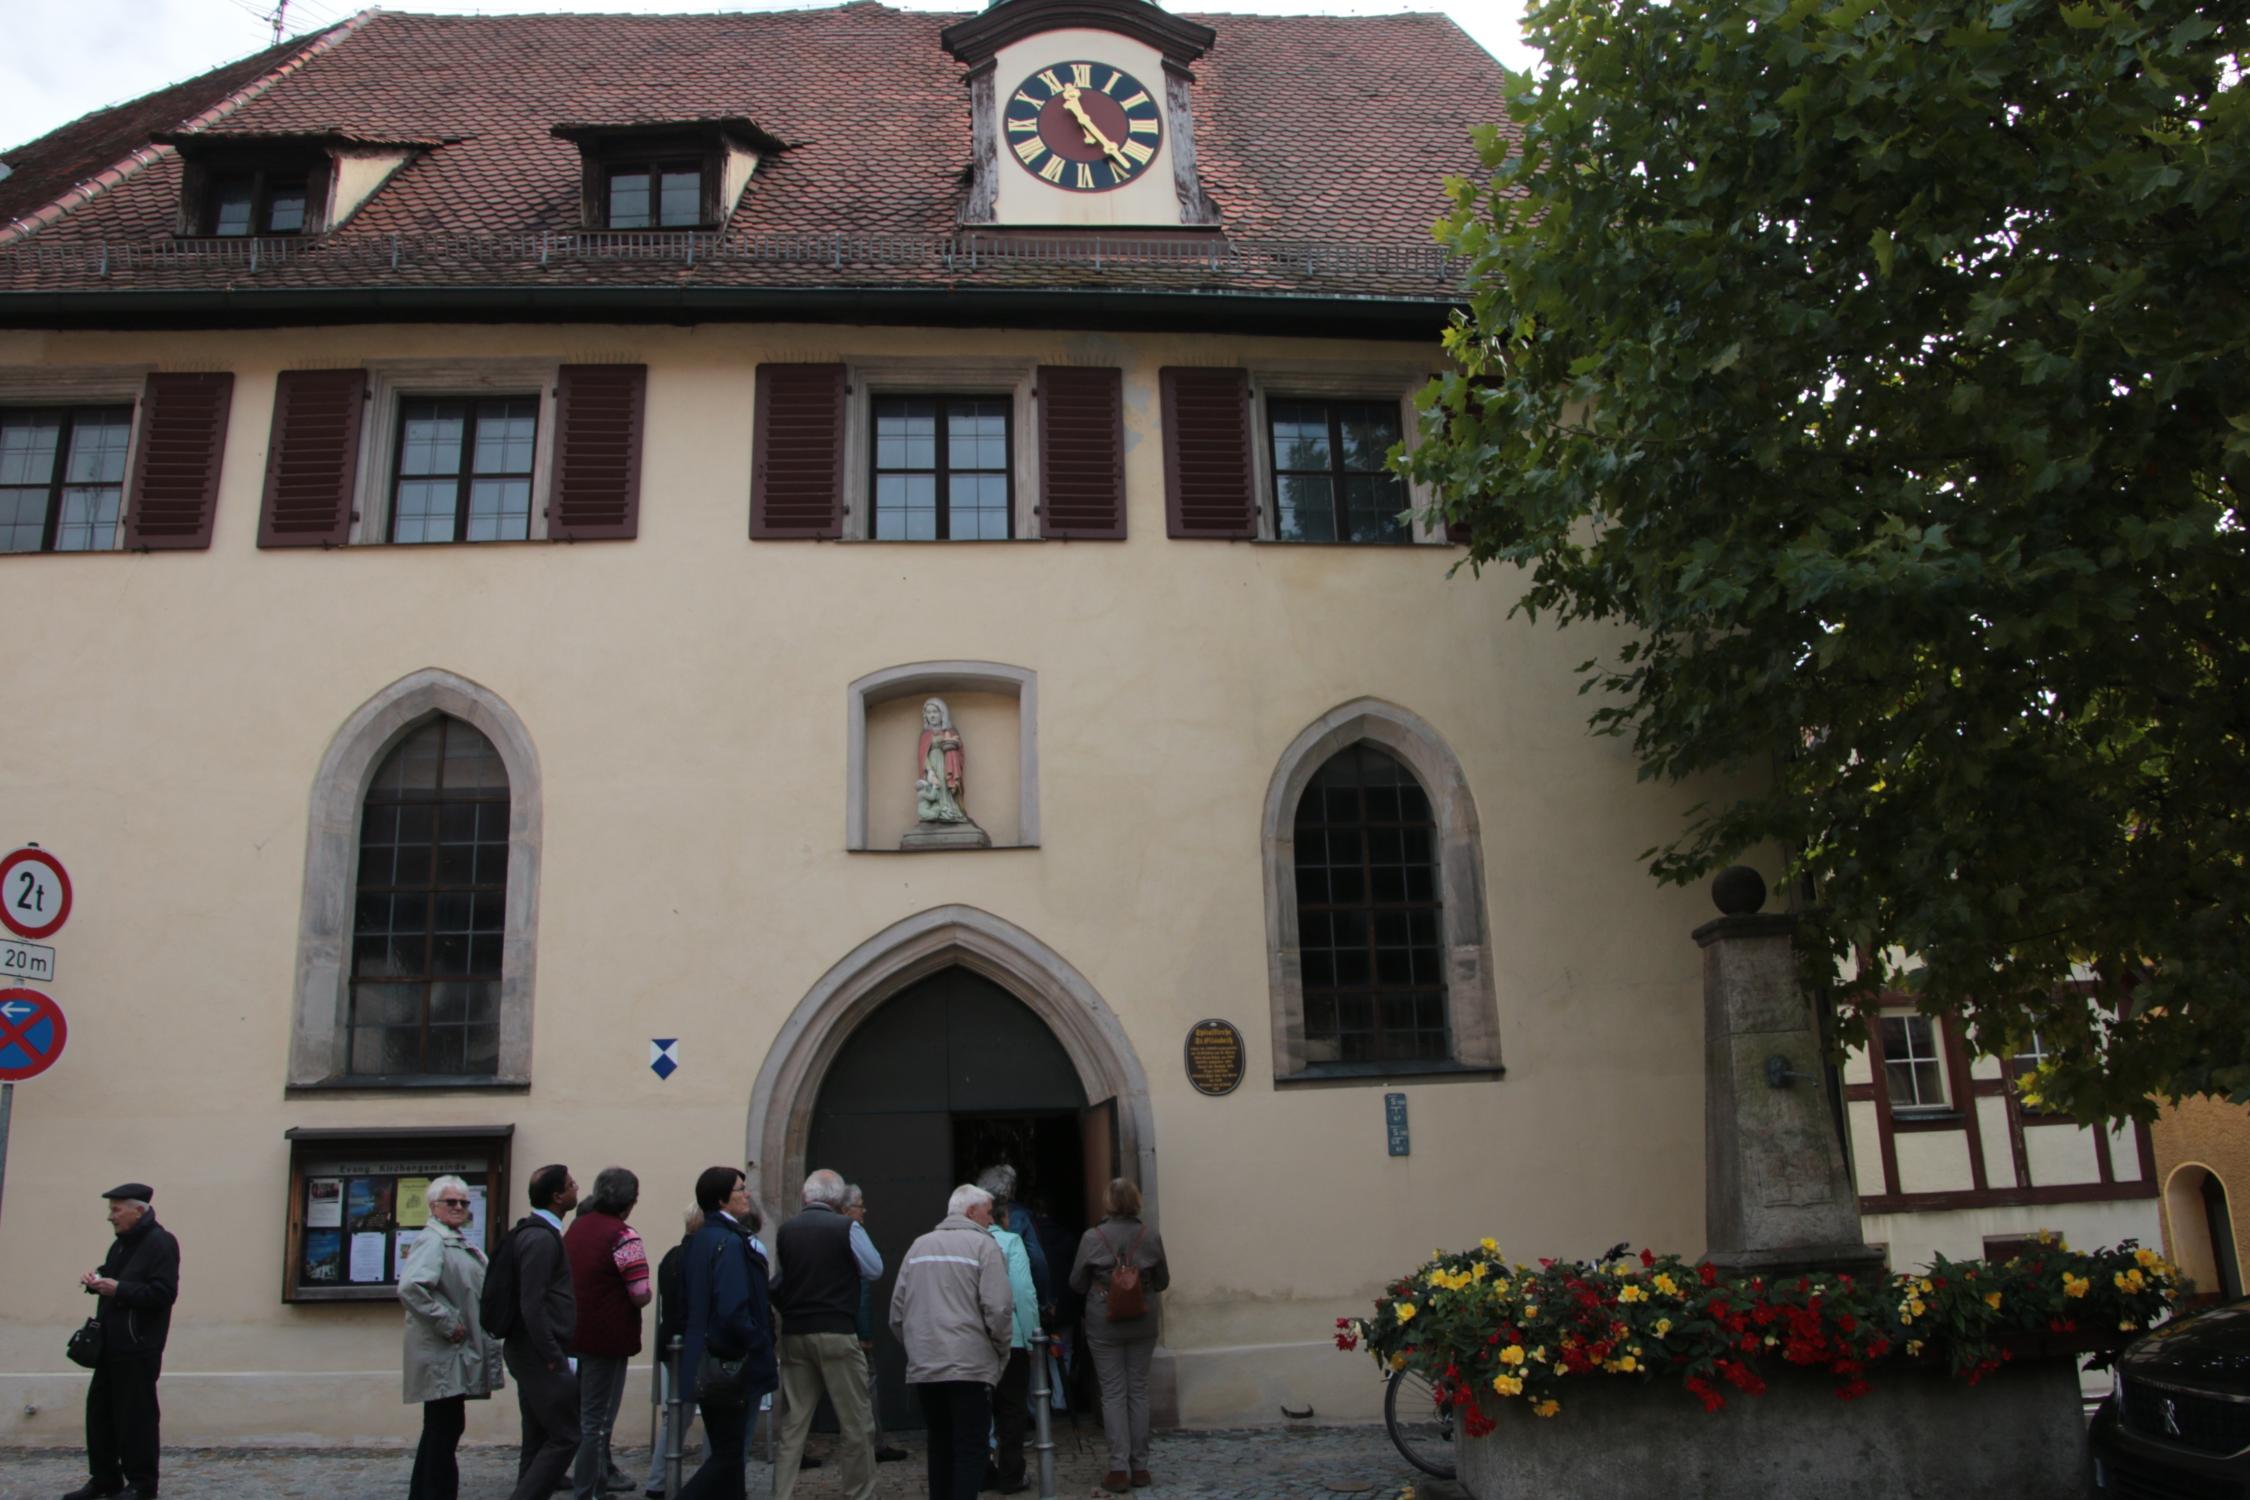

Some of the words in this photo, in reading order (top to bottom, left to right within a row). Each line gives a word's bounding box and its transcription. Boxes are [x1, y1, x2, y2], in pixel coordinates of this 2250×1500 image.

[1037, 69, 1064, 96] XI
[1070, 64, 1092, 89] XII
[1101, 71, 1122, 95] I
[1014, 89, 1046, 111] X
[1119, 90, 1150, 111] II
[1007, 117, 1038, 132] IX
[1128, 118, 1159, 135] III
[4, 948, 27, 968] 20
[30, 957, 47, 972] m
[378, 1163, 467, 1174] Kirchengemeinde
